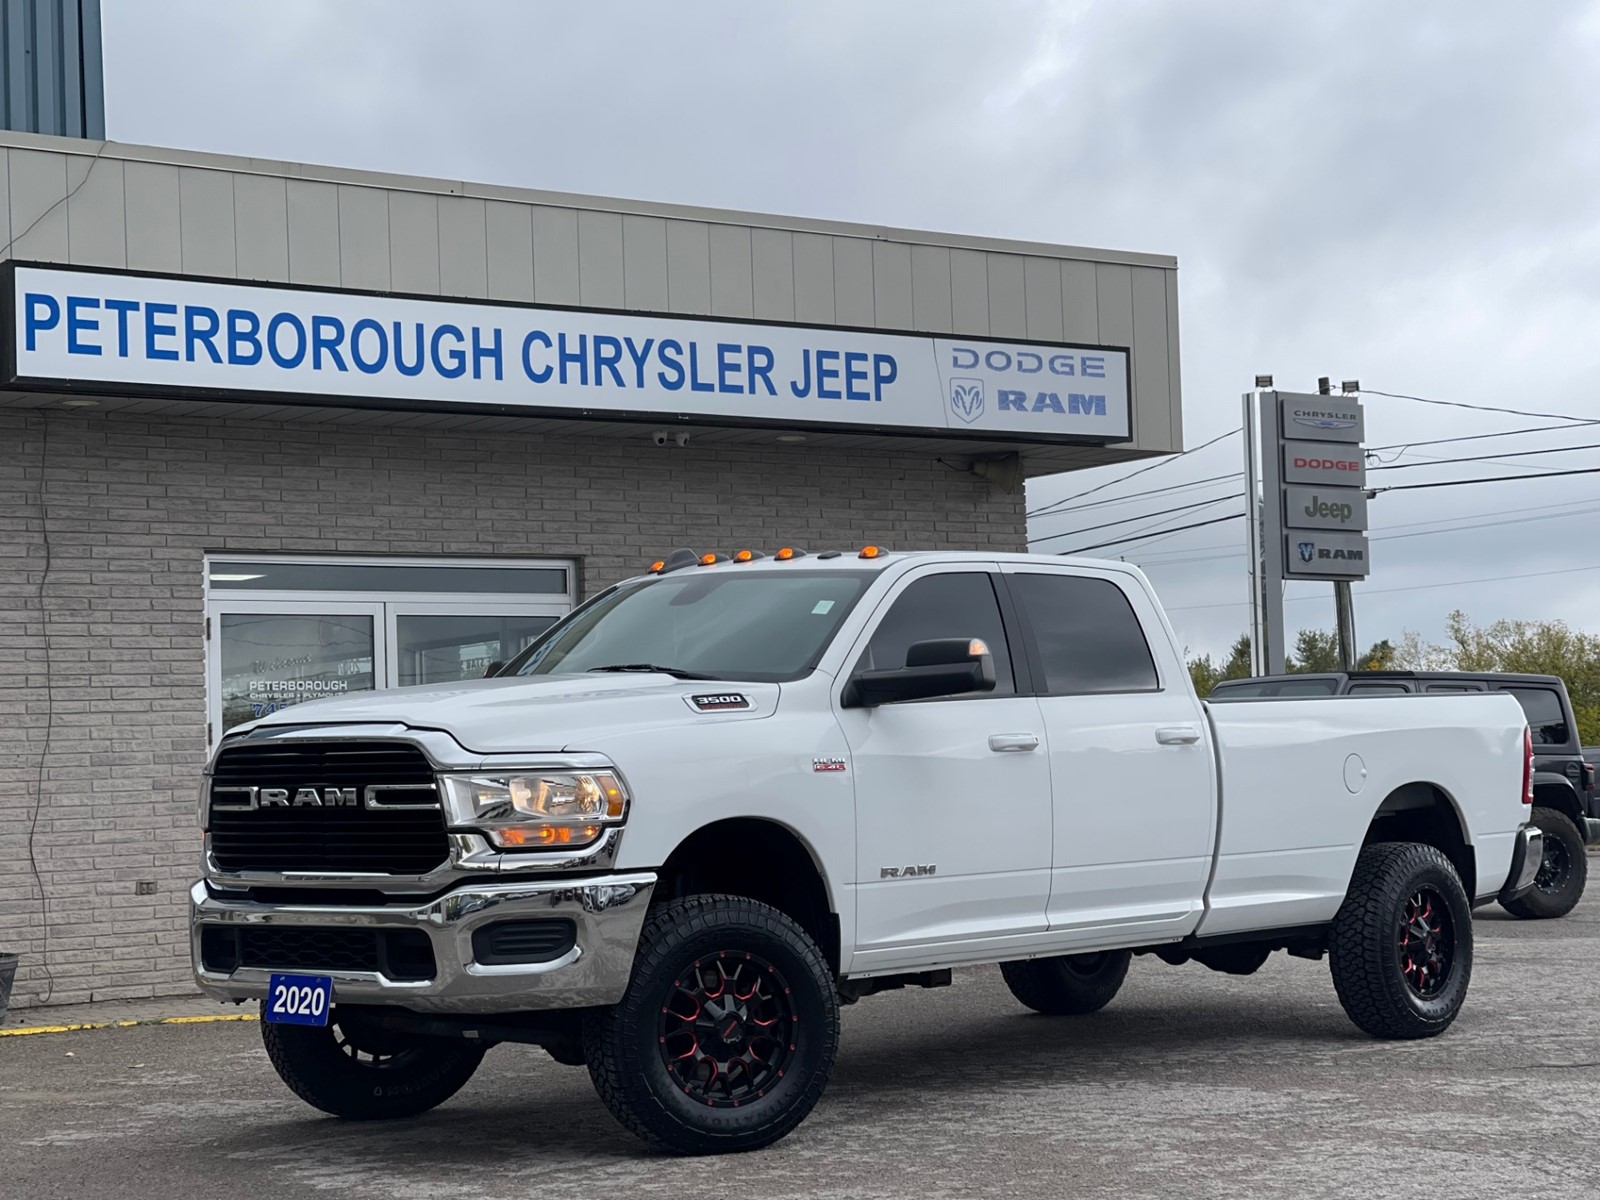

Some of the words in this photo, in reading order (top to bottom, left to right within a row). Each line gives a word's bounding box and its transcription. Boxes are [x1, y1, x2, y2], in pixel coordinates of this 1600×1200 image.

[24, 292, 504, 381] PETERBOROUGH
[521, 329, 777, 396] CHRYSLER
[790, 348, 898, 402] JEEP
[952, 347, 1106, 379] DODGE
[997, 389, 1107, 416] RAM
[1293, 409, 1358, 421] CHRYSLER
[1293, 457, 1360, 472] DODGE
[1304, 495, 1353, 523] Jeep
[1317, 548, 1364, 561] RAM
[249, 680, 348, 691] PETERBOROUGH
[696, 695, 742, 705] 3500
[259, 787, 358, 807] RAM
[880, 864, 937, 878] RAM
[272, 984, 325, 1016] 2020
